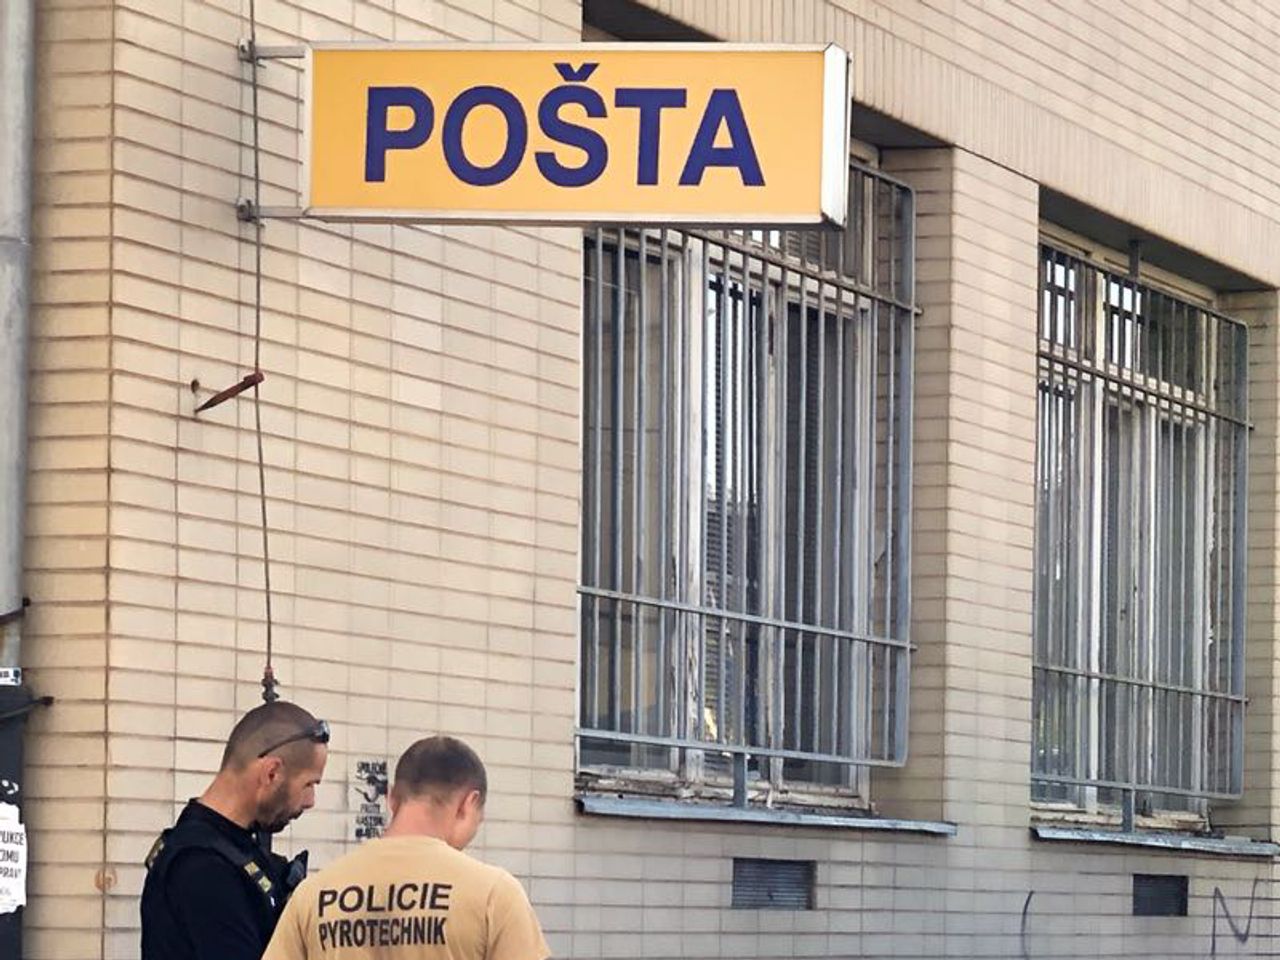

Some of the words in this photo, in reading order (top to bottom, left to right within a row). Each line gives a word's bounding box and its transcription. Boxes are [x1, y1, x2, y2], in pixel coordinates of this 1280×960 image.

[365, 62, 765, 187] POŠTA
[318, 883, 453, 918] POLICIE
[318, 916, 447, 951] PYROTECHNIK
